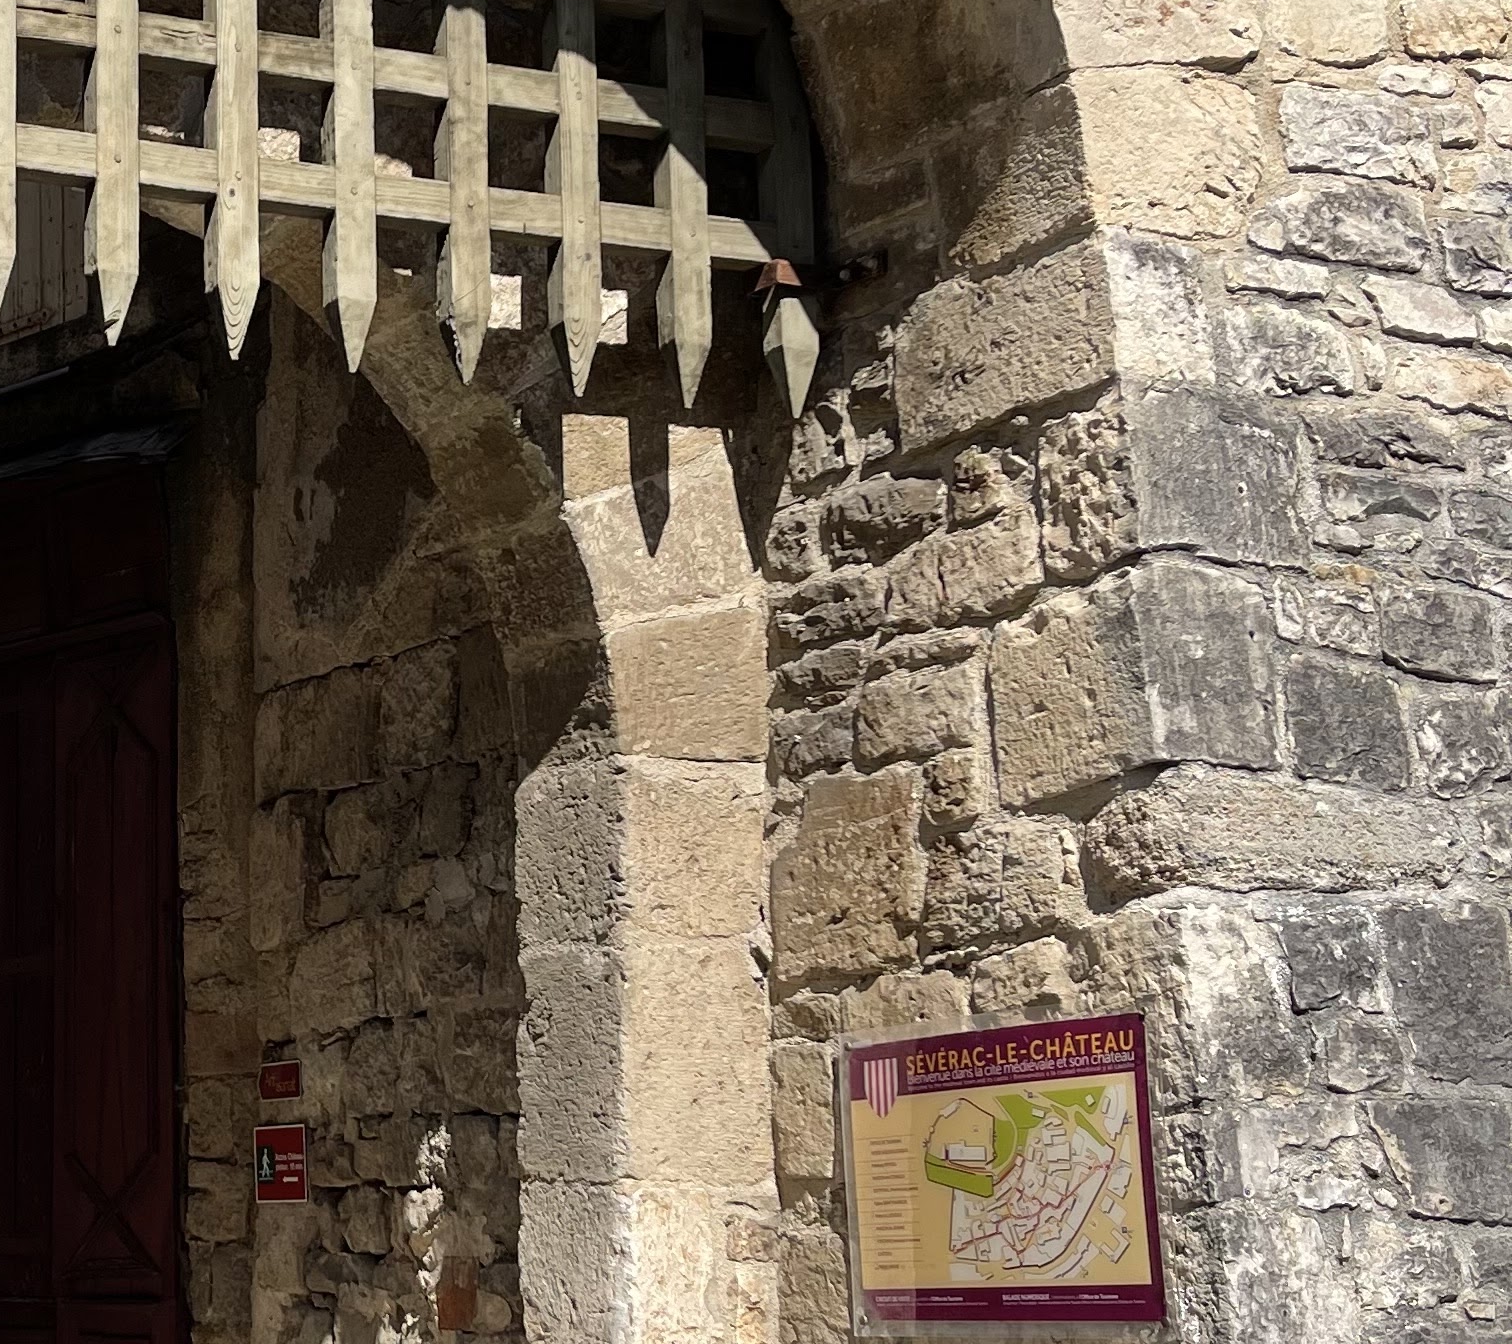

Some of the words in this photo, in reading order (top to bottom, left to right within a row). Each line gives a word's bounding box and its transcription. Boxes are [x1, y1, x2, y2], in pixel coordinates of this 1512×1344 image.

[906, 1029, 1133, 1076] SÉVÉRAC-LE-CHÂTEAU
[907, 1070, 951, 1085] Bienvenue
[951, 1066, 974, 1080] dans
[974, 1064, 984, 1077] la
[1056, 1056, 1068, 1069] et
[1069, 1055, 1090, 1067] son
